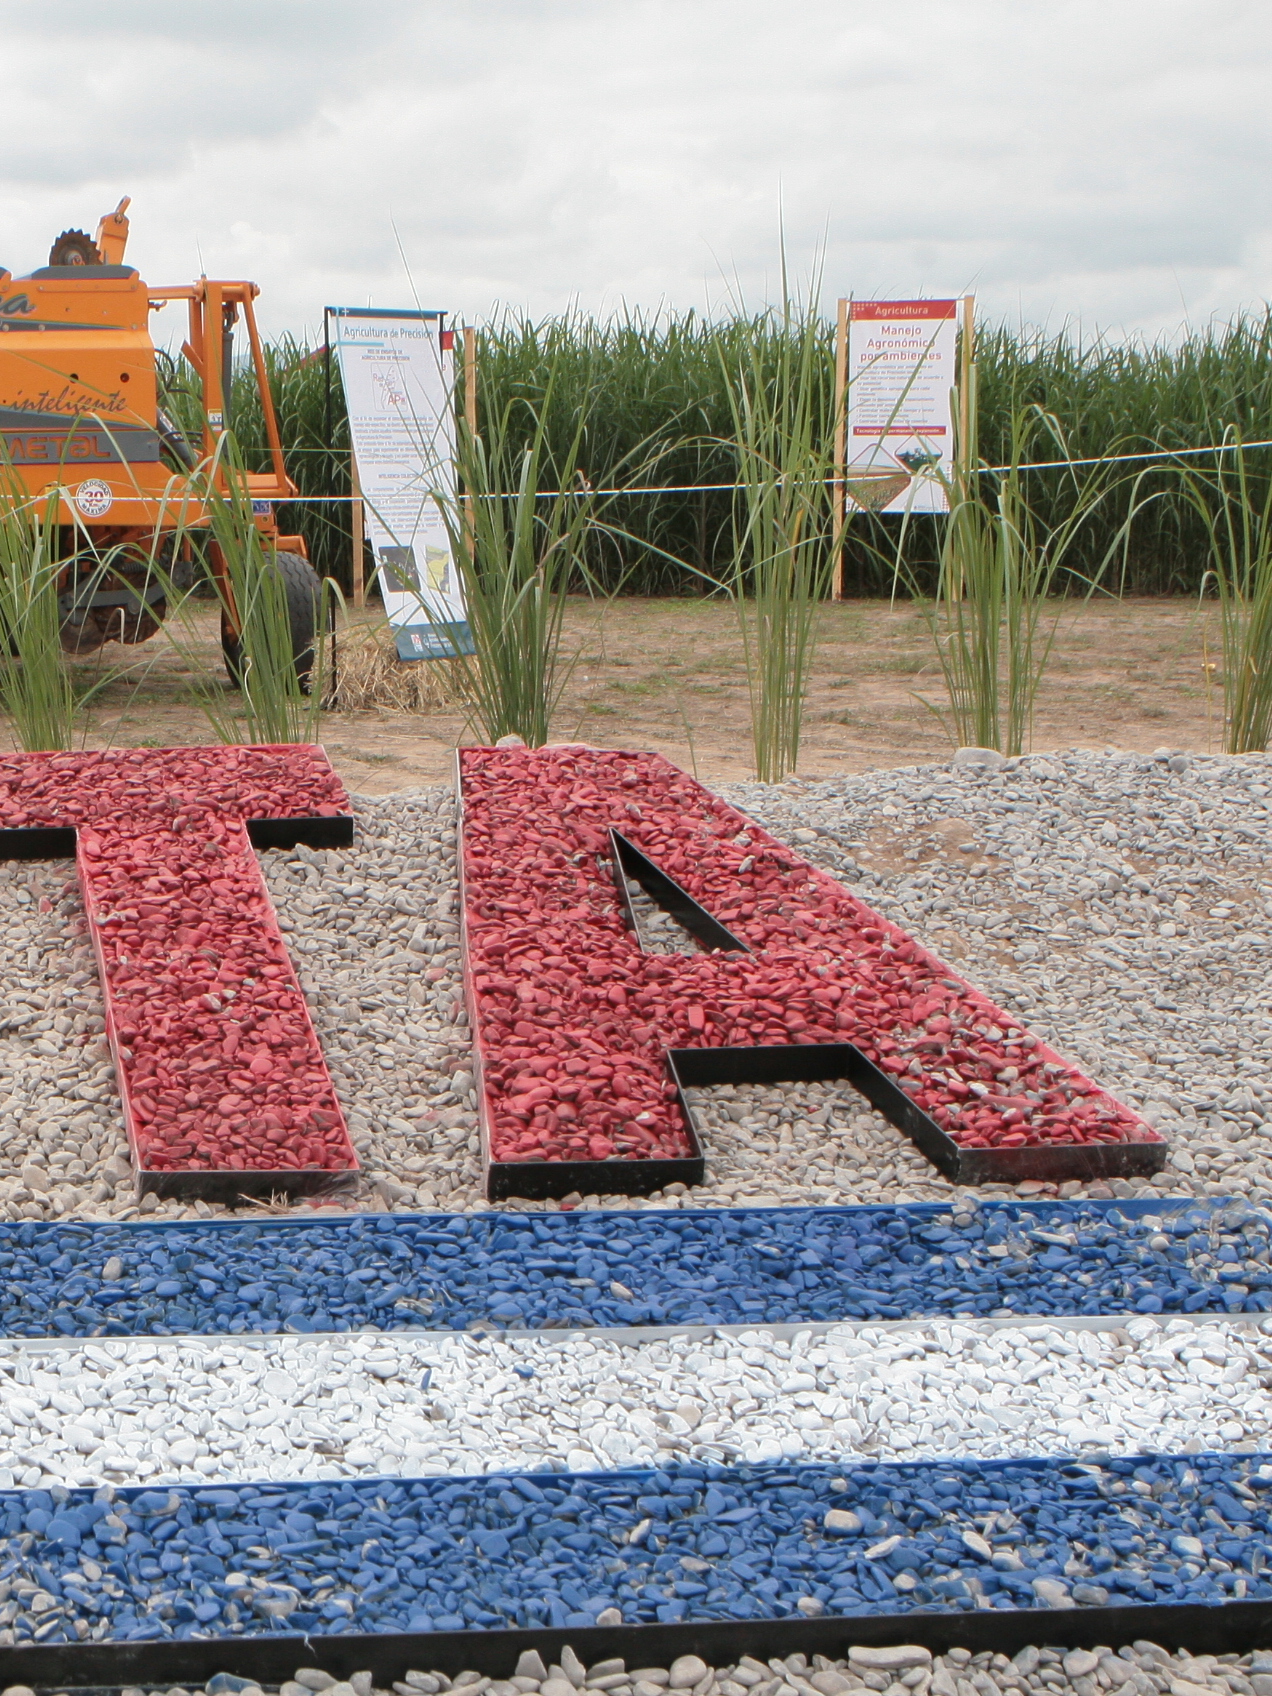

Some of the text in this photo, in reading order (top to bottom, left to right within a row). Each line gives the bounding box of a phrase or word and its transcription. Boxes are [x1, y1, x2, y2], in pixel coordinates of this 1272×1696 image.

[875, 306, 928, 316] Agricultura
[343, 326, 388, 339] Agricultura
[390, 329, 399, 338] de
[881, 325, 922, 337] Manejo
[867, 338, 935, 350] Agronómico
[882, 351, 942, 361] ambienes
[9, 386, 127, 418] inteligente
[85, 490, 104, 503] 30
